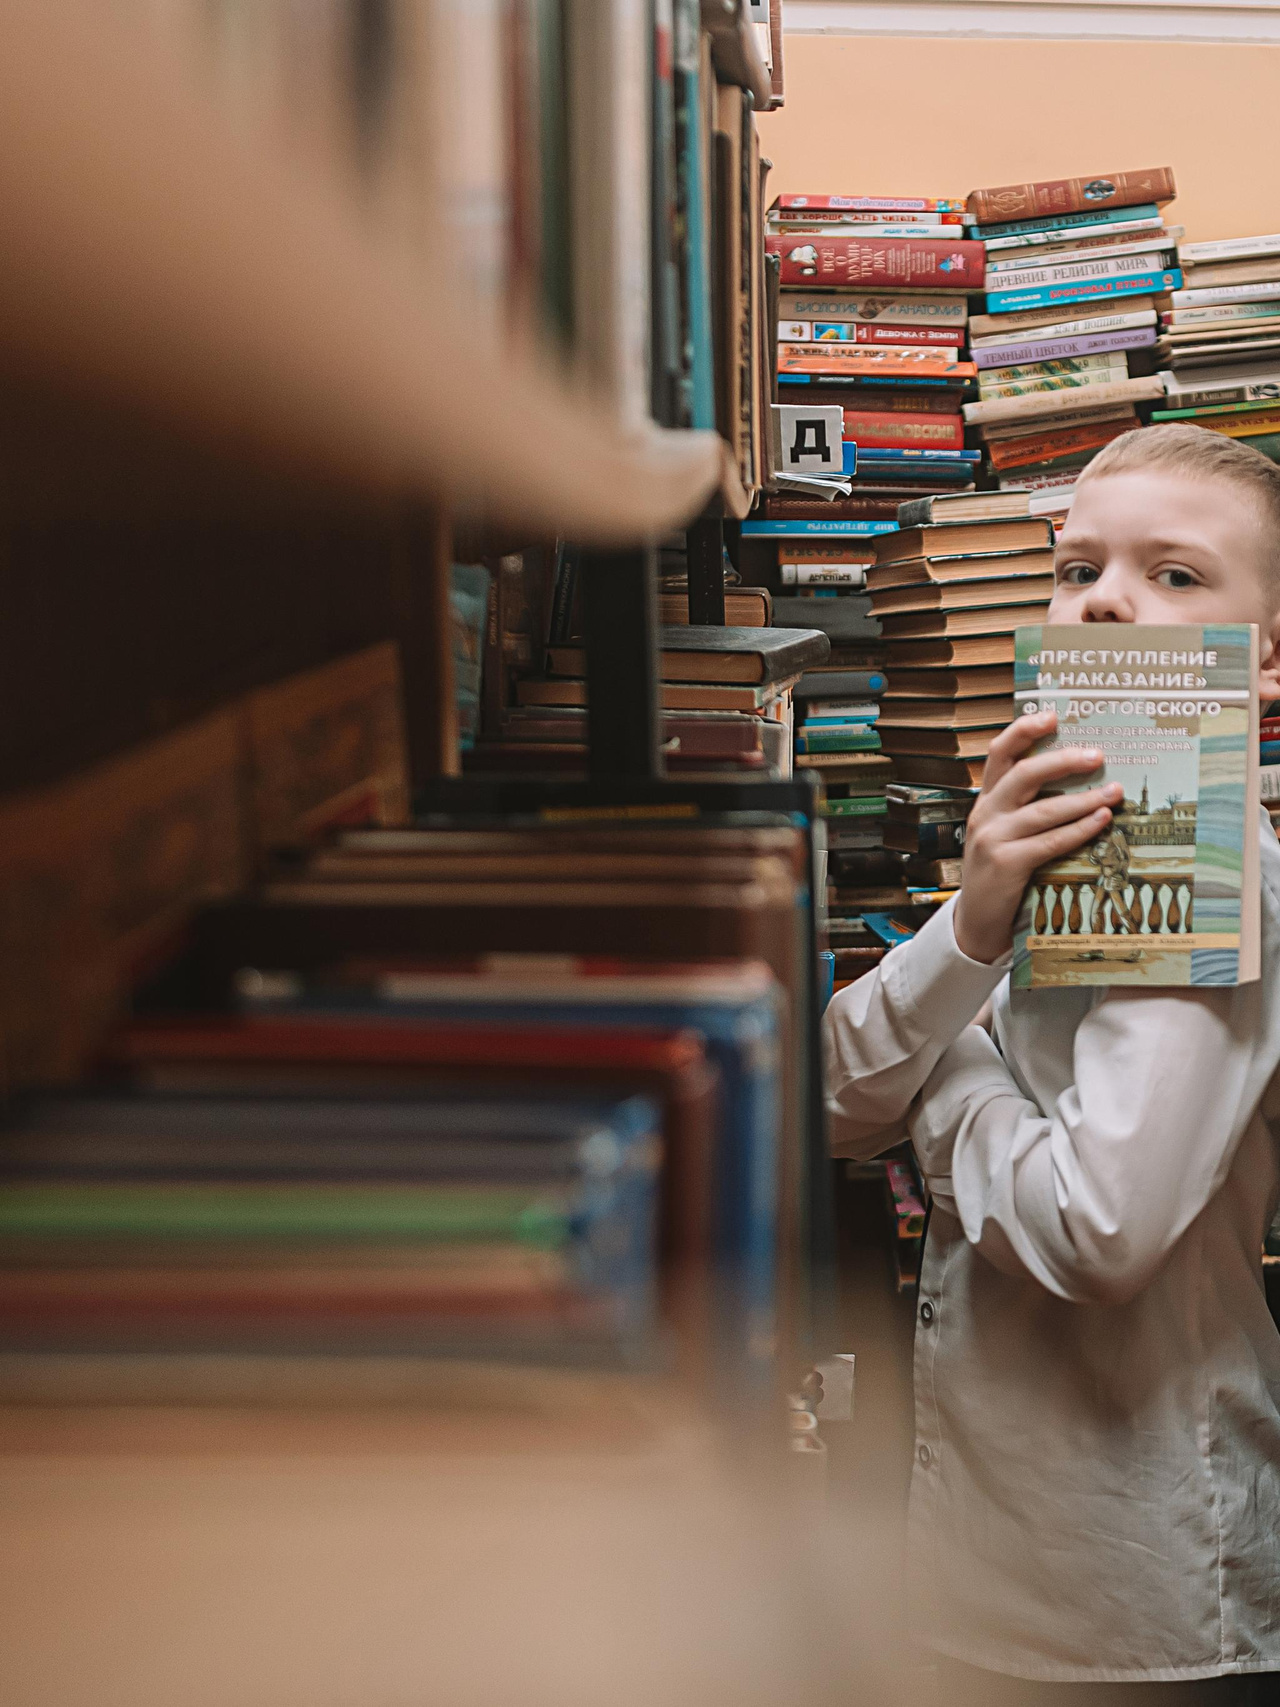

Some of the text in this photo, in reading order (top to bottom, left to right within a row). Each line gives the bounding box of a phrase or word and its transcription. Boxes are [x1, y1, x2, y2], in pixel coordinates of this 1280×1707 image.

[992, 257, 1149, 289] ДРЕВНИЕ РЕЛИГИИ МИРА
[1050, 281, 1113, 299] БРОНЗОВАЯ
[1116, 278, 1154, 290] ПТИЦА
[795, 302, 962, 316] БИОЛОГИЯ АНАТОМИЯ
[984, 347, 1033, 364] ТЕМНЫЙ
[1035, 342, 1080, 360] ЦВЕТОК
[790, 419, 831, 463] Д
[807, 522, 869, 531] ЛИТЕРАТУРЫ
[1028, 650, 1218, 667] «ПРЕСТУПЛЕНИЕ
[1036, 671, 1208, 688] И НАКАЗАНИЕ»
[1065, 701, 1222, 718] ДОСТОЕВСКОГО
[1105, 726, 1192, 738] СОДЕРЖАНИЕ.
